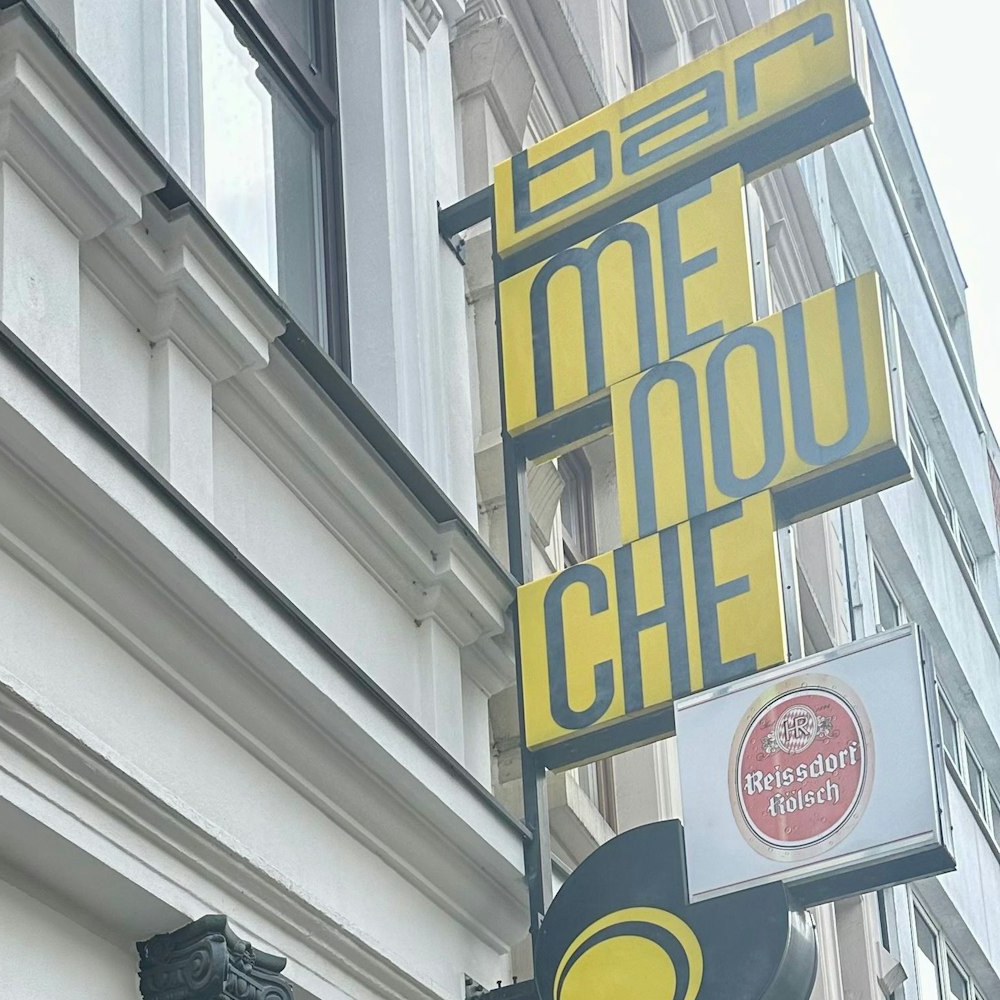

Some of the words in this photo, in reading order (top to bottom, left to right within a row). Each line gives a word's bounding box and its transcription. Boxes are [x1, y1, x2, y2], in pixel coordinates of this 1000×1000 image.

[511, 13, 834, 234] bar
[544, 500, 757, 730] CHE
[743, 740, 861, 796] Reissdorf
[767, 780, 840, 817] Kölsch
